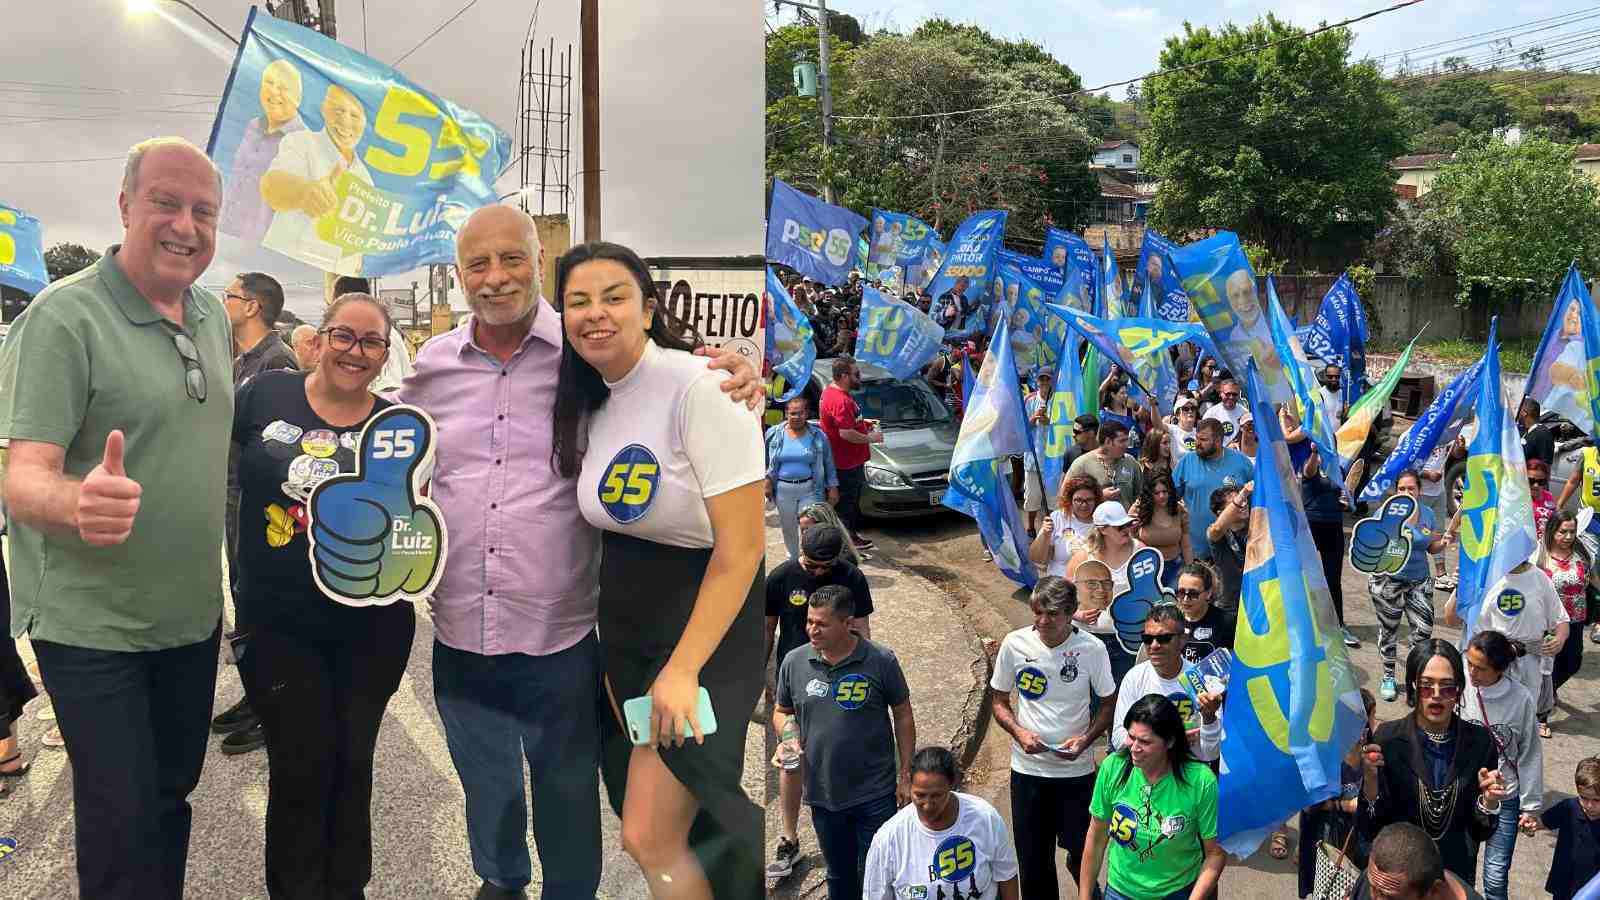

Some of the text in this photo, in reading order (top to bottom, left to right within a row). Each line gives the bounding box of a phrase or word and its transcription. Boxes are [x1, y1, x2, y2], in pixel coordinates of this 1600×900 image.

[339, 195, 377, 232] Dr.
[693, 291, 759, 338] FEITO
[372, 429, 416, 459] 55
[601, 463, 658, 505] 55
[1388, 503, 1409, 516] 55
[392, 519, 412, 532] Dr.
[391, 531, 433, 549] Luiz
[1132, 557, 1155, 579] 55
[1500, 594, 1522, 611] 55
[836, 681, 869, 702] 55
[1018, 671, 1046, 695] 55
[938, 840, 974, 878] 55
